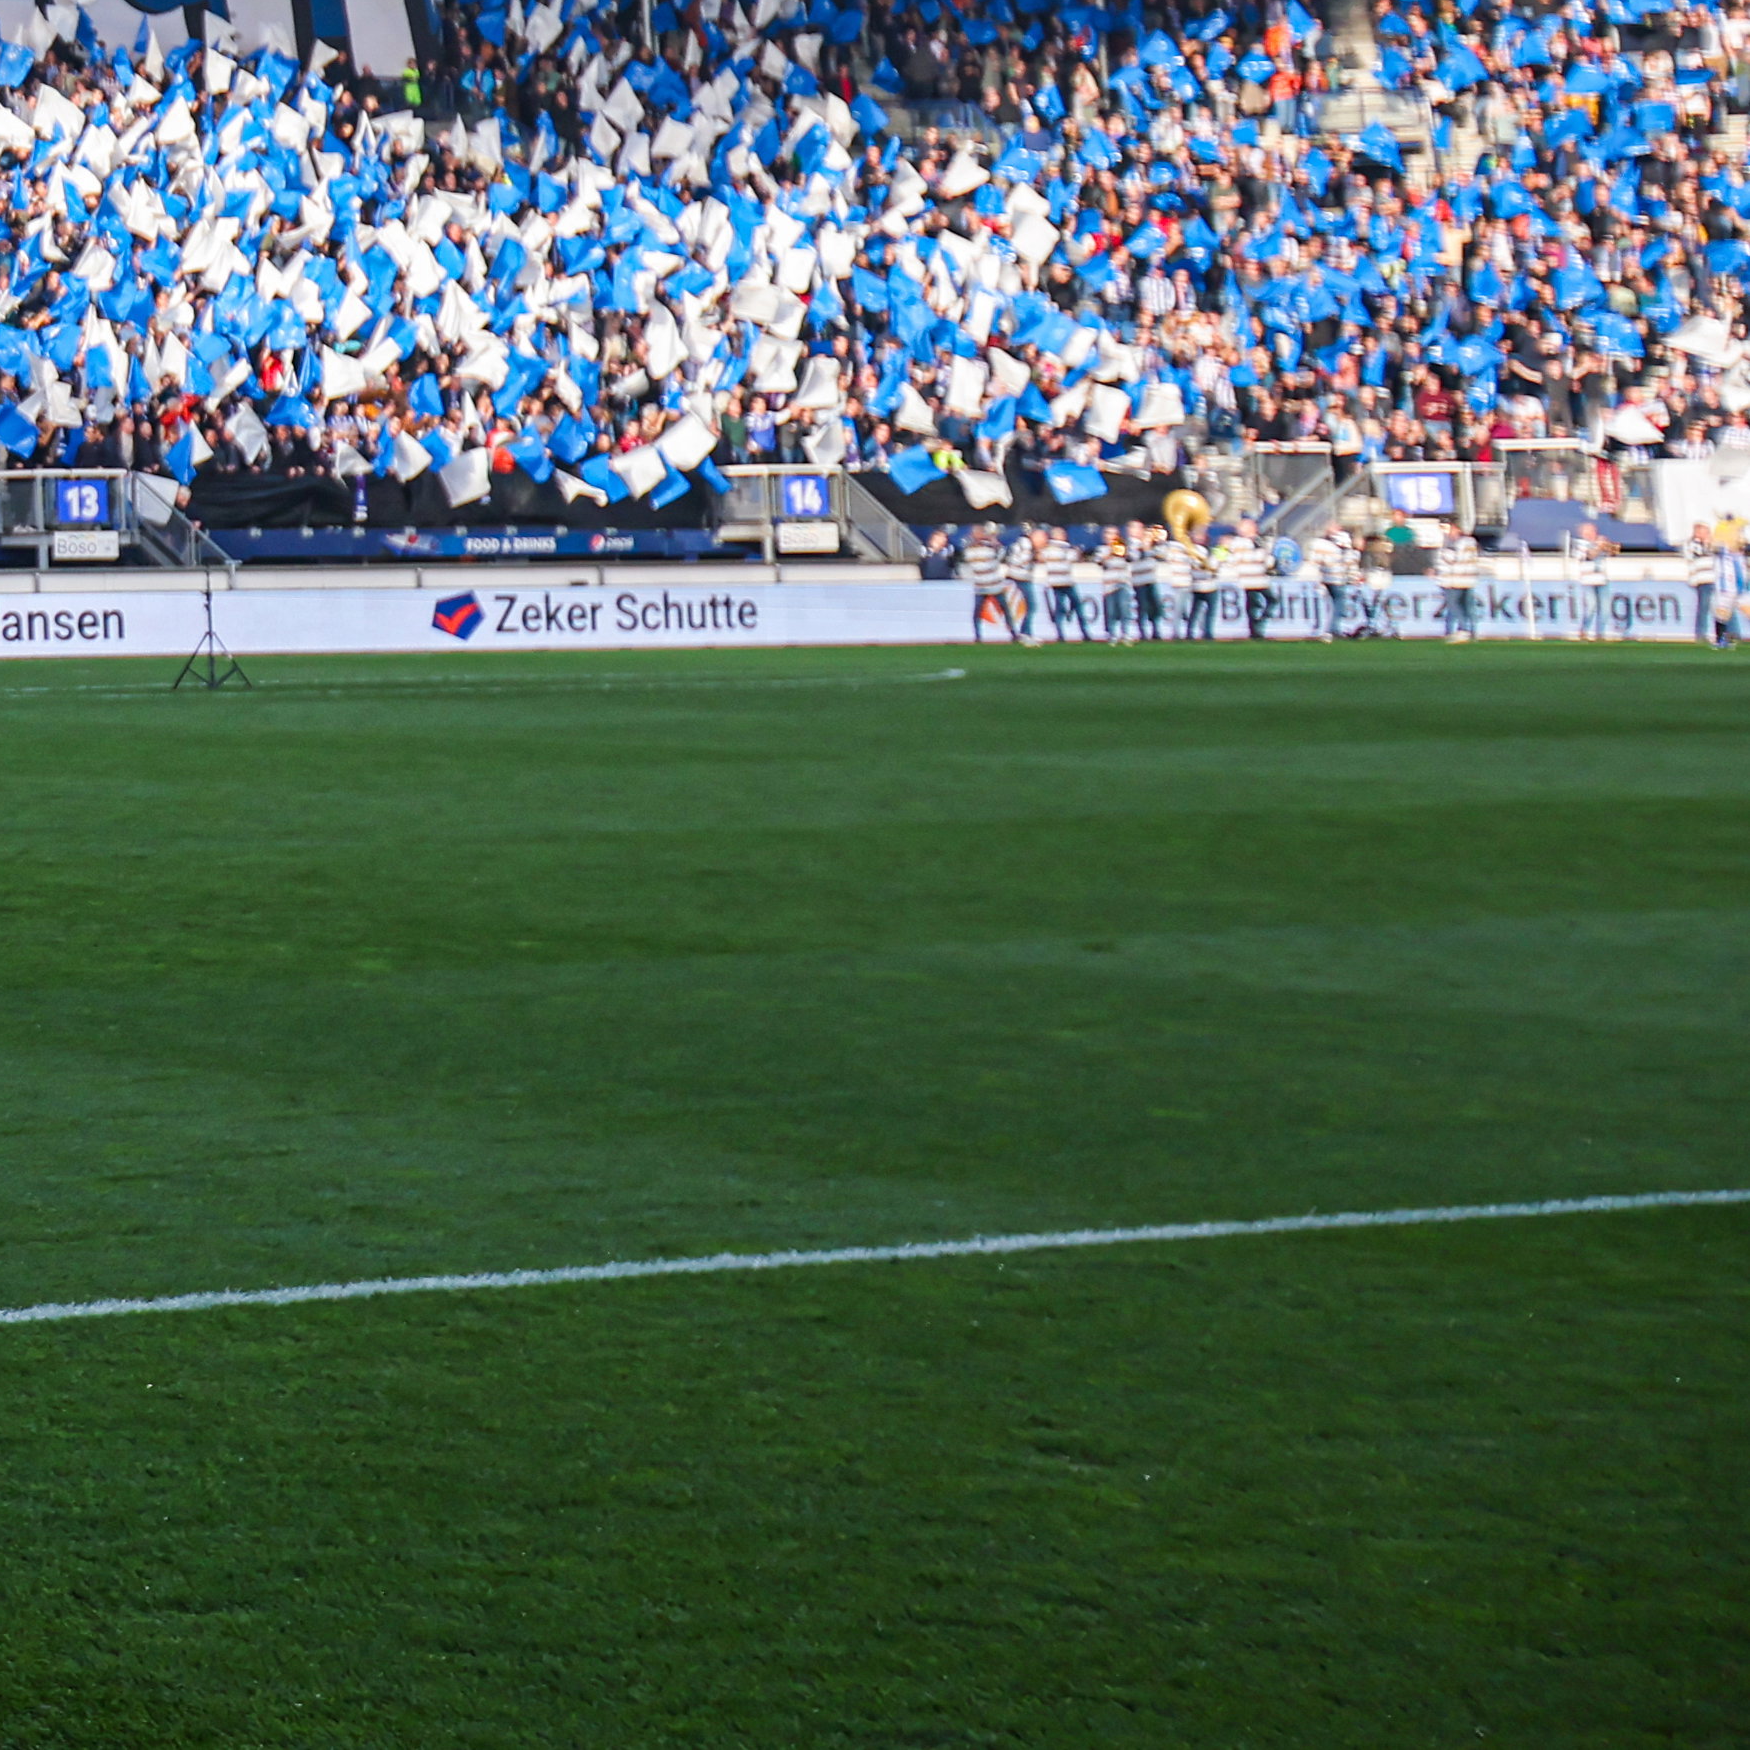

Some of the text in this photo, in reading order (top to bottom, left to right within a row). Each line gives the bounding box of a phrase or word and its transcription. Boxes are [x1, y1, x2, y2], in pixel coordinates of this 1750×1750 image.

[67, 485, 100, 520] 13
[789, 479, 823, 515] 14
[1400, 476, 1443, 512] 15
[466, 536, 499, 552] FOOD
[494, 589, 759, 633] Zeker Schutte
